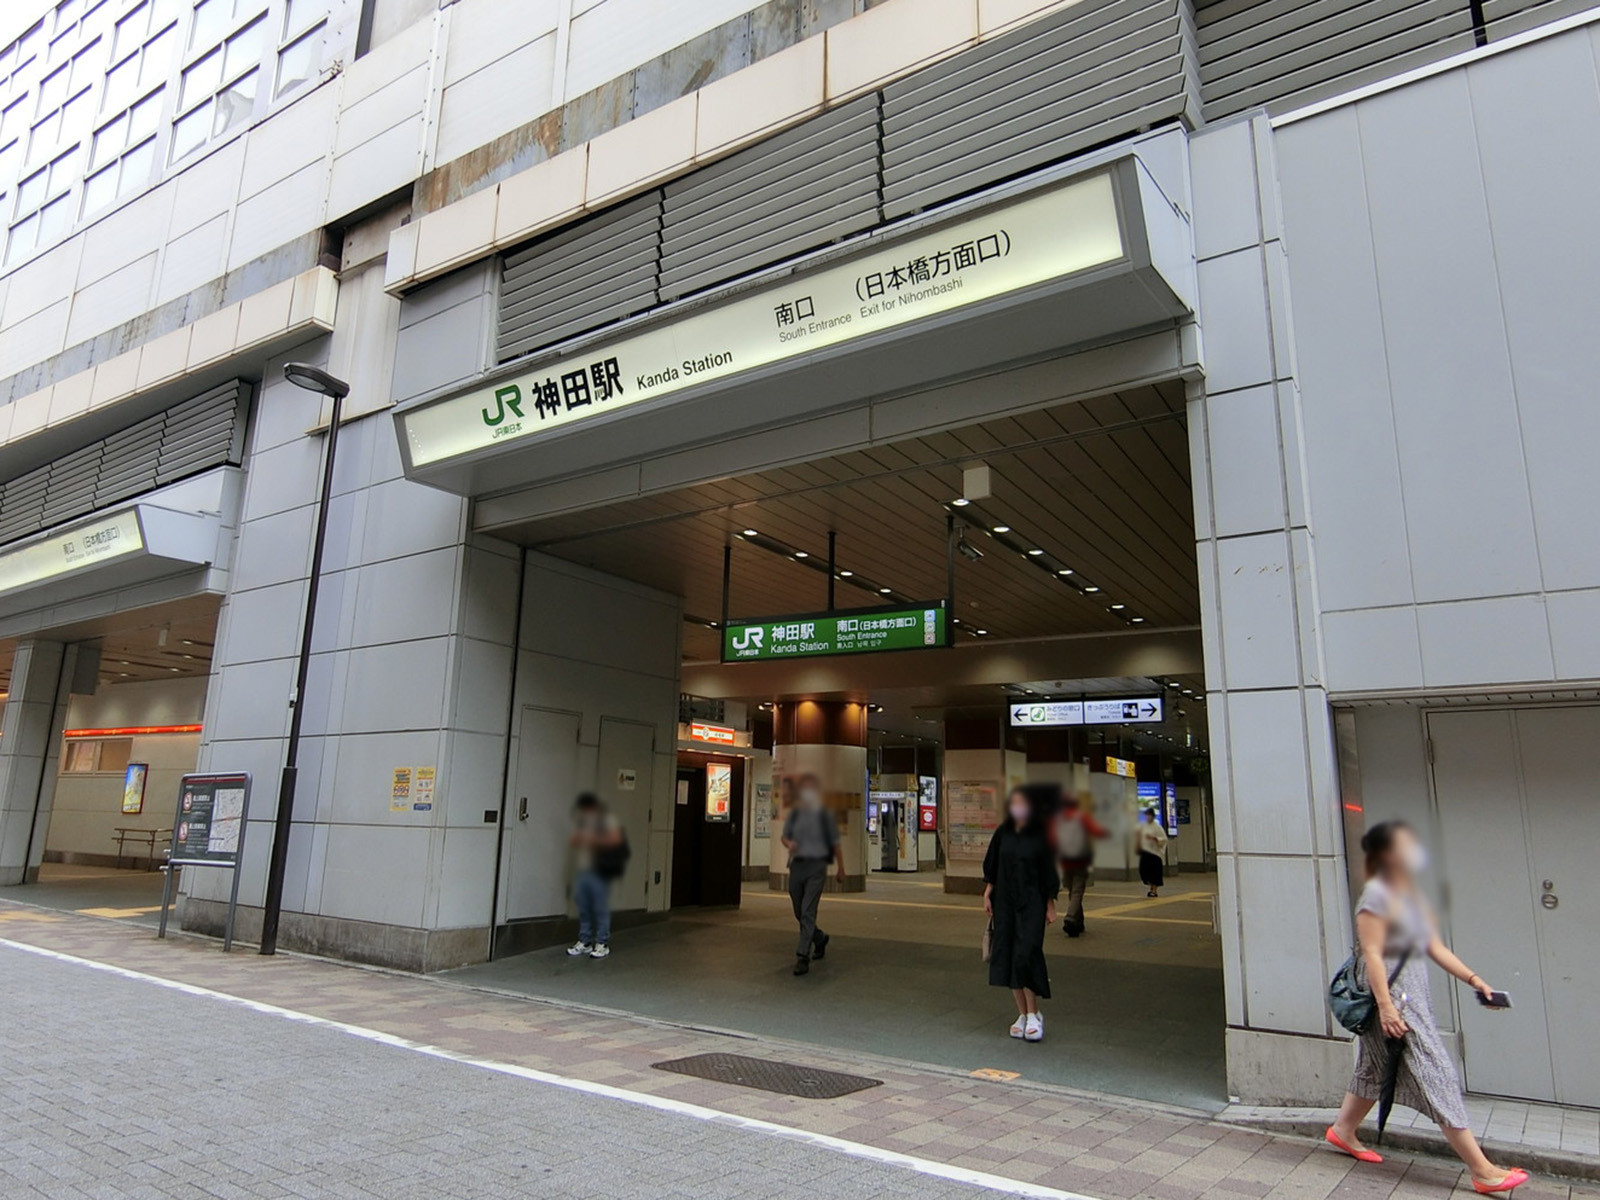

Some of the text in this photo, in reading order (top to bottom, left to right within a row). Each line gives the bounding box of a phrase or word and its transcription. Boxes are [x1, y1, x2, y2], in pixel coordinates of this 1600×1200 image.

[774, 229, 1011, 327] 南口 (日本橋方面口)
[779, 277, 963, 343] South Entrance Exit for Nihombashi
[532, 356, 624, 420] 神田駅
[636, 351, 733, 391] Kanda Station
[482, 384, 525, 427] JR
[732, 627, 764, 650] JR
[770, 640, 829, 654] Kanda Station
[771, 623, 815, 642] 神田駅
[837, 631, 887, 642] South Entrance
